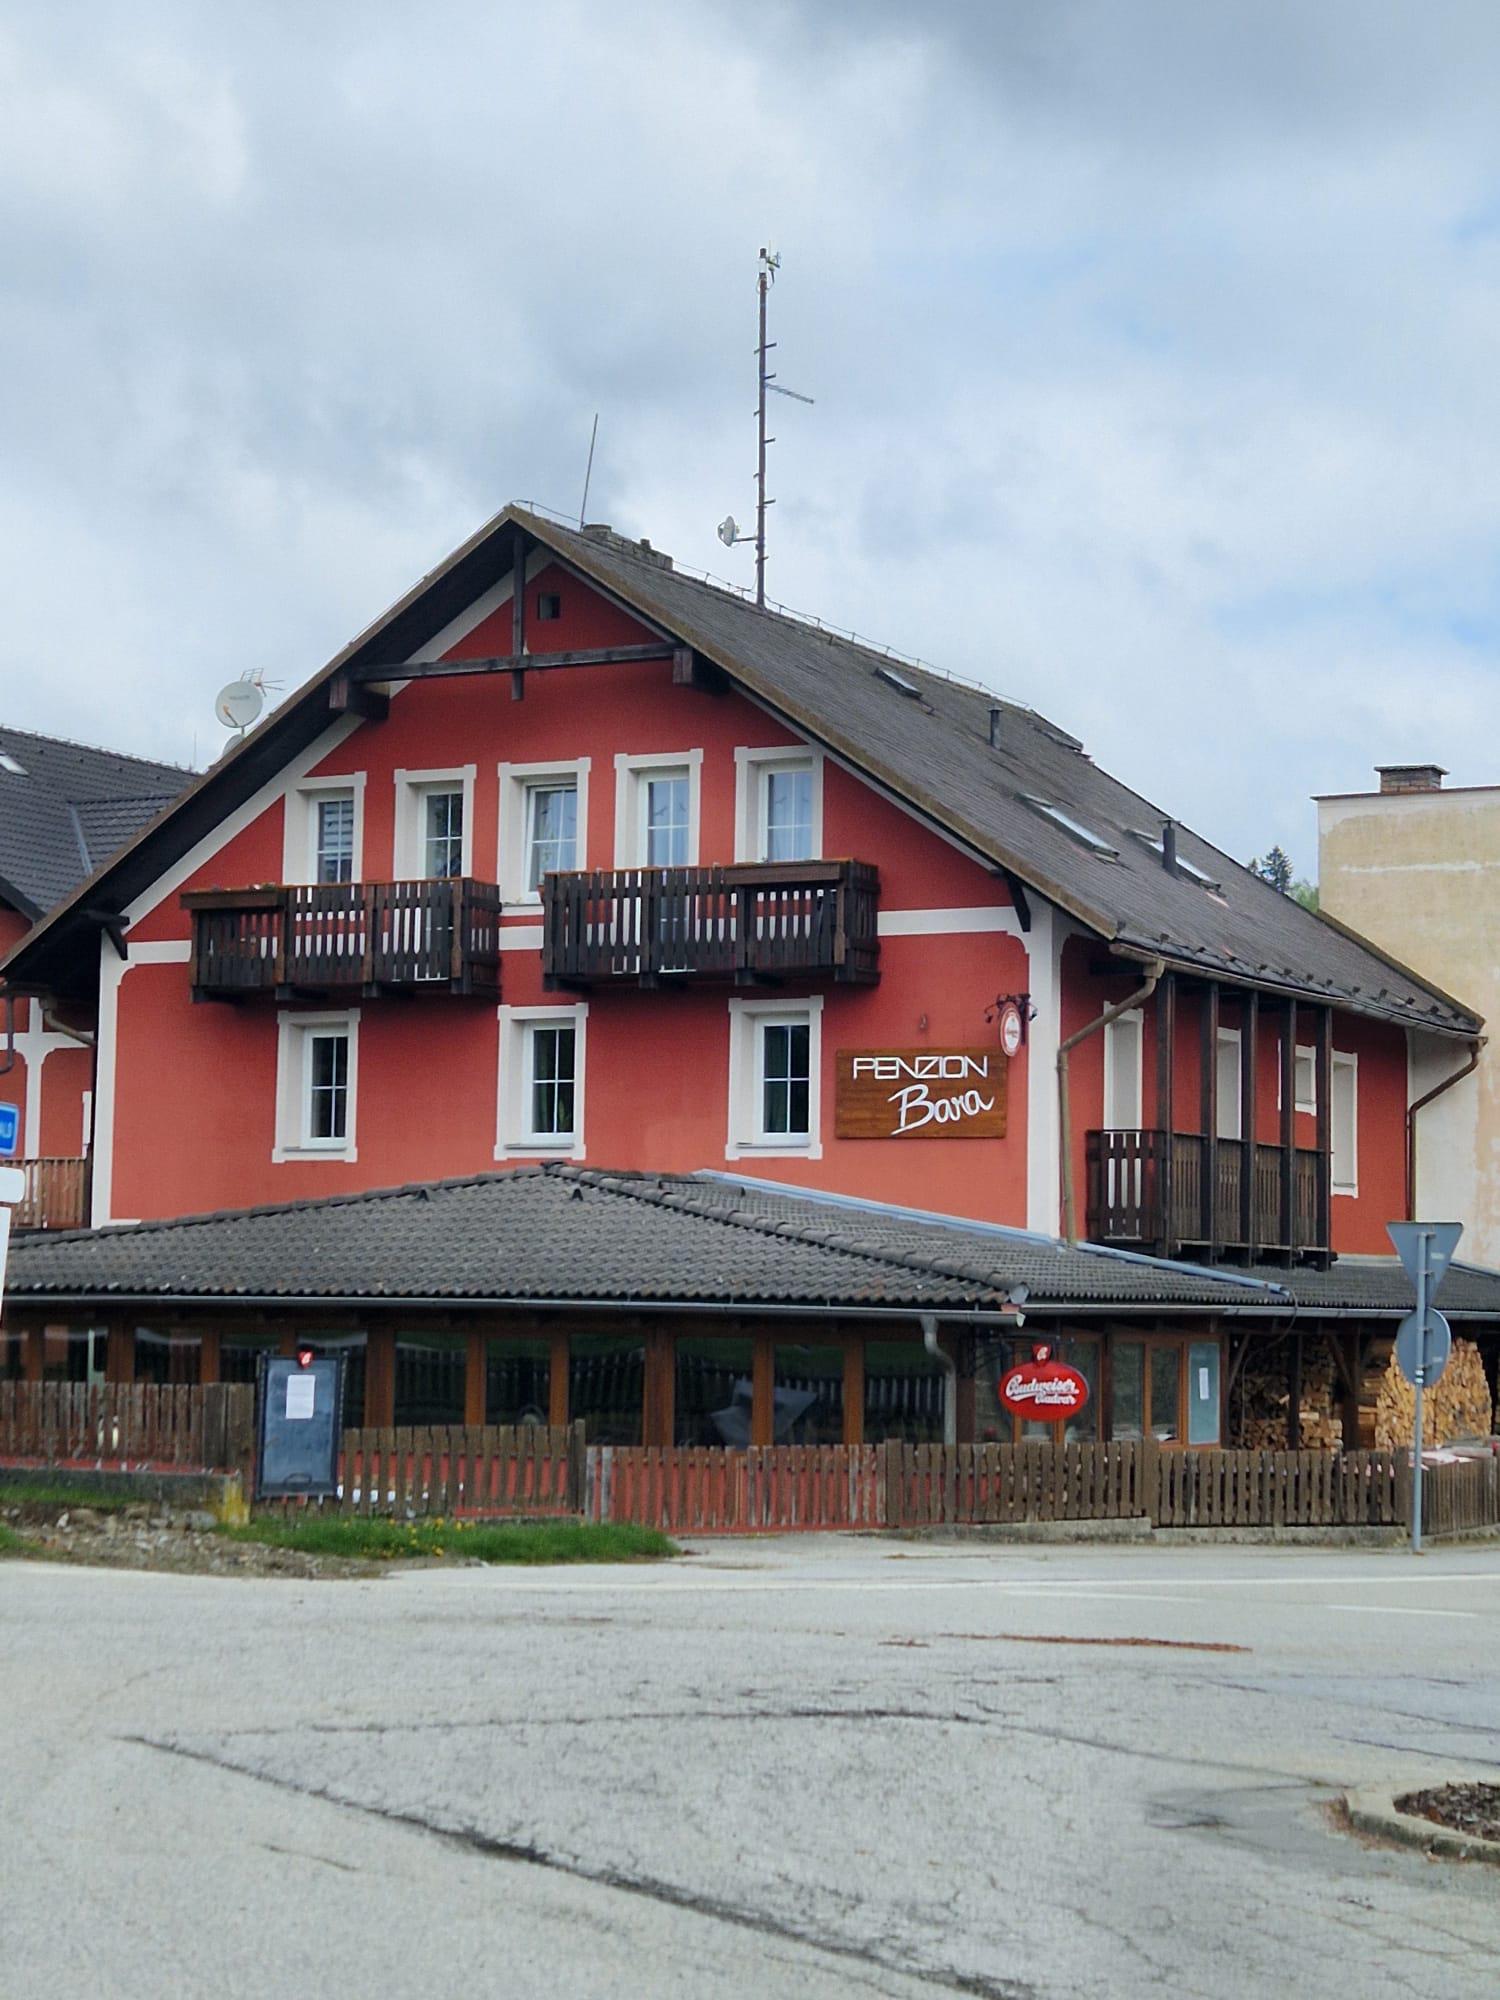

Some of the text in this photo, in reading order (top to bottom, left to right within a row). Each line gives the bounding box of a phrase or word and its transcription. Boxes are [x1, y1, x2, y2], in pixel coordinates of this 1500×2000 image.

[853, 1056, 988, 1079] PENZION
[888, 1083, 995, 1135] Bara
[1006, 1374, 1080, 1401] Budweiser
